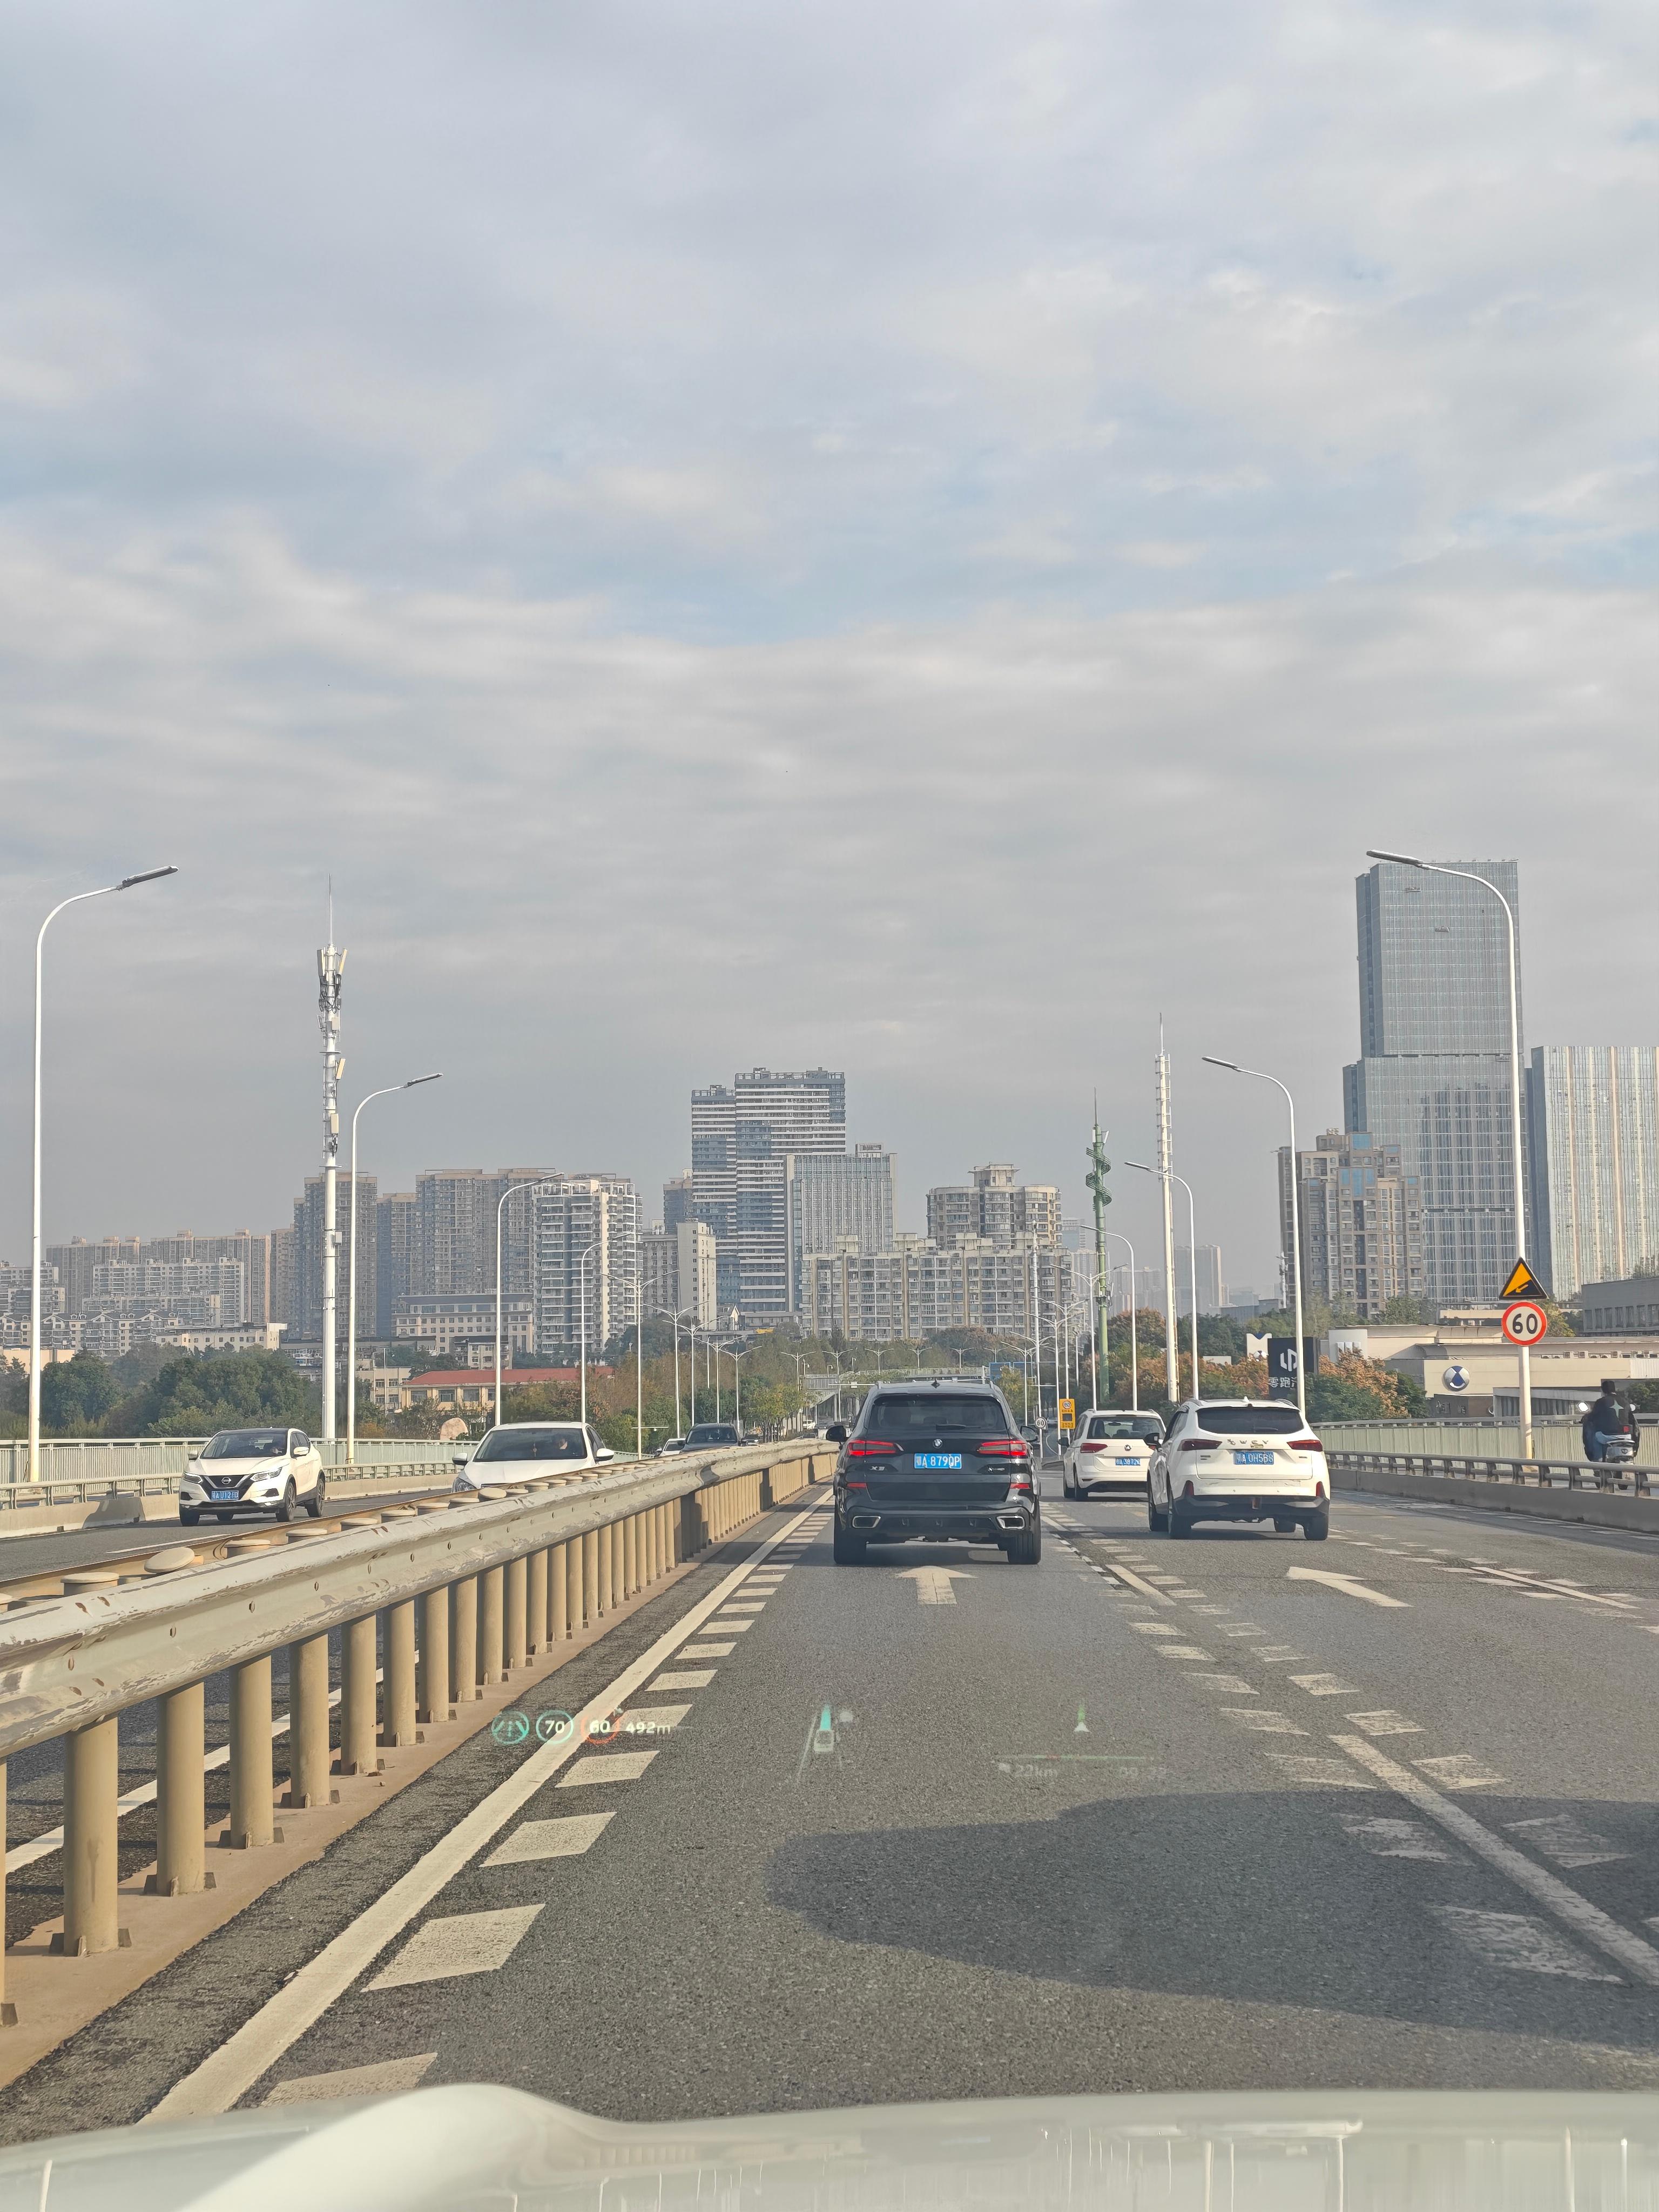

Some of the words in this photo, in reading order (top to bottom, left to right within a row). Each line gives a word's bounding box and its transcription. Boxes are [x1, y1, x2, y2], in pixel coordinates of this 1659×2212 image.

[1513, 1313, 1537, 1334] 60
[545, 1720, 565, 1735] 70
[589, 1720, 610, 1734] 60
[626, 1721, 671, 1735] 492m
